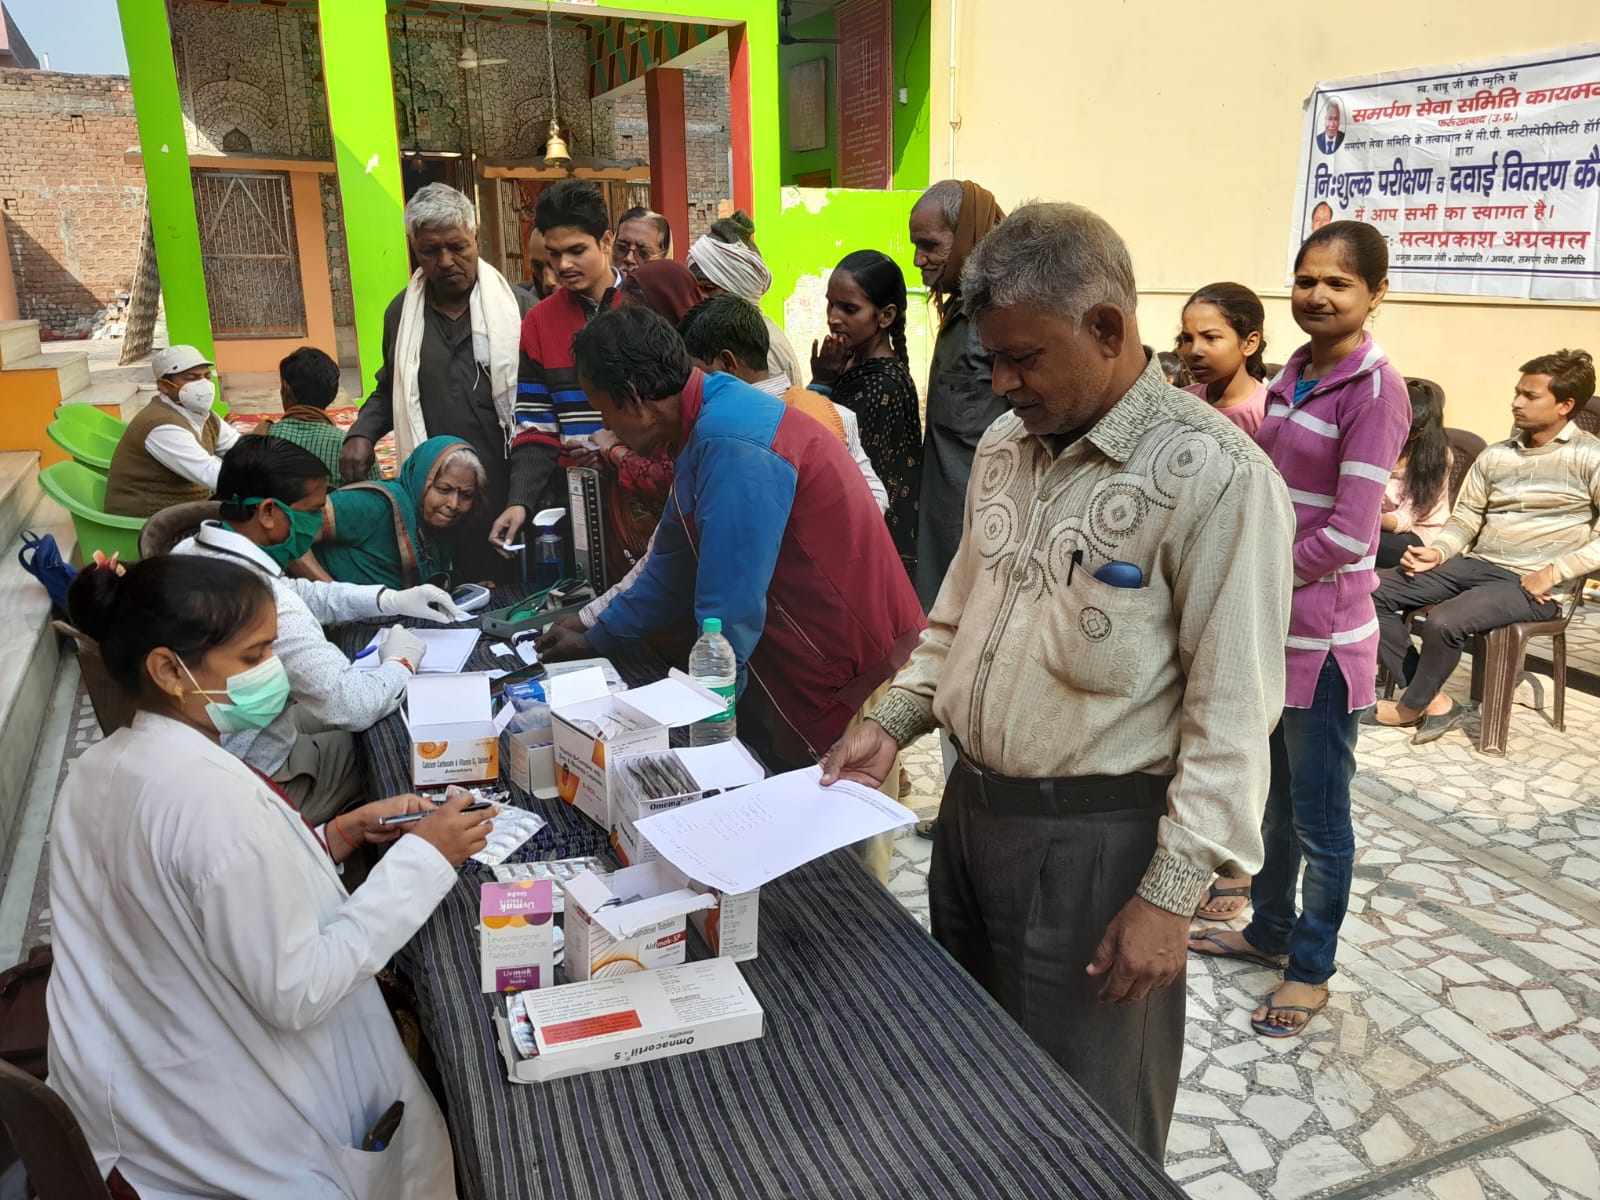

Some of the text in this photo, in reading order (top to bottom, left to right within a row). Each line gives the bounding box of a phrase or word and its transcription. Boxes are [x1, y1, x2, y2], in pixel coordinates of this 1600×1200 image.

[1432, 82, 1449, 94] बाबू
[1452, 78, 1464, 89] जी
[1467, 76, 1479, 88] की
[1482, 73, 1505, 89] स्मृति
[1509, 72, 1518, 82] में
[1352, 81, 1600, 123] समर्पण सेवा समिति कायम
[1369, 137, 1383, 148] सेवा
[1386, 134, 1411, 148] समिति
[1415, 134, 1422, 145] के
[1465, 129, 1474, 141] में
[1455, 146, 1474, 157] द्वारा
[1378, 157, 1433, 196] परीक्षण
[1436, 176, 1446, 194] व
[1450, 150, 1498, 198] दवाई
[1502, 150, 1571, 192] वितरण
[1354, 205, 1365, 221] में
[1371, 208, 1399, 221] आप
[1404, 203, 1438, 221] सभी
[1444, 206, 1466, 220] का
[1472, 205, 1528, 220] स्वागत
[1399, 231, 1497, 249] सत्यप्रकाश
[1503, 231, 1591, 250] अग्रवाल
[1413, 254, 1432, 262] समाज
[1543, 254, 1559, 265] सेवा
[1560, 254, 1586, 266] समिति
